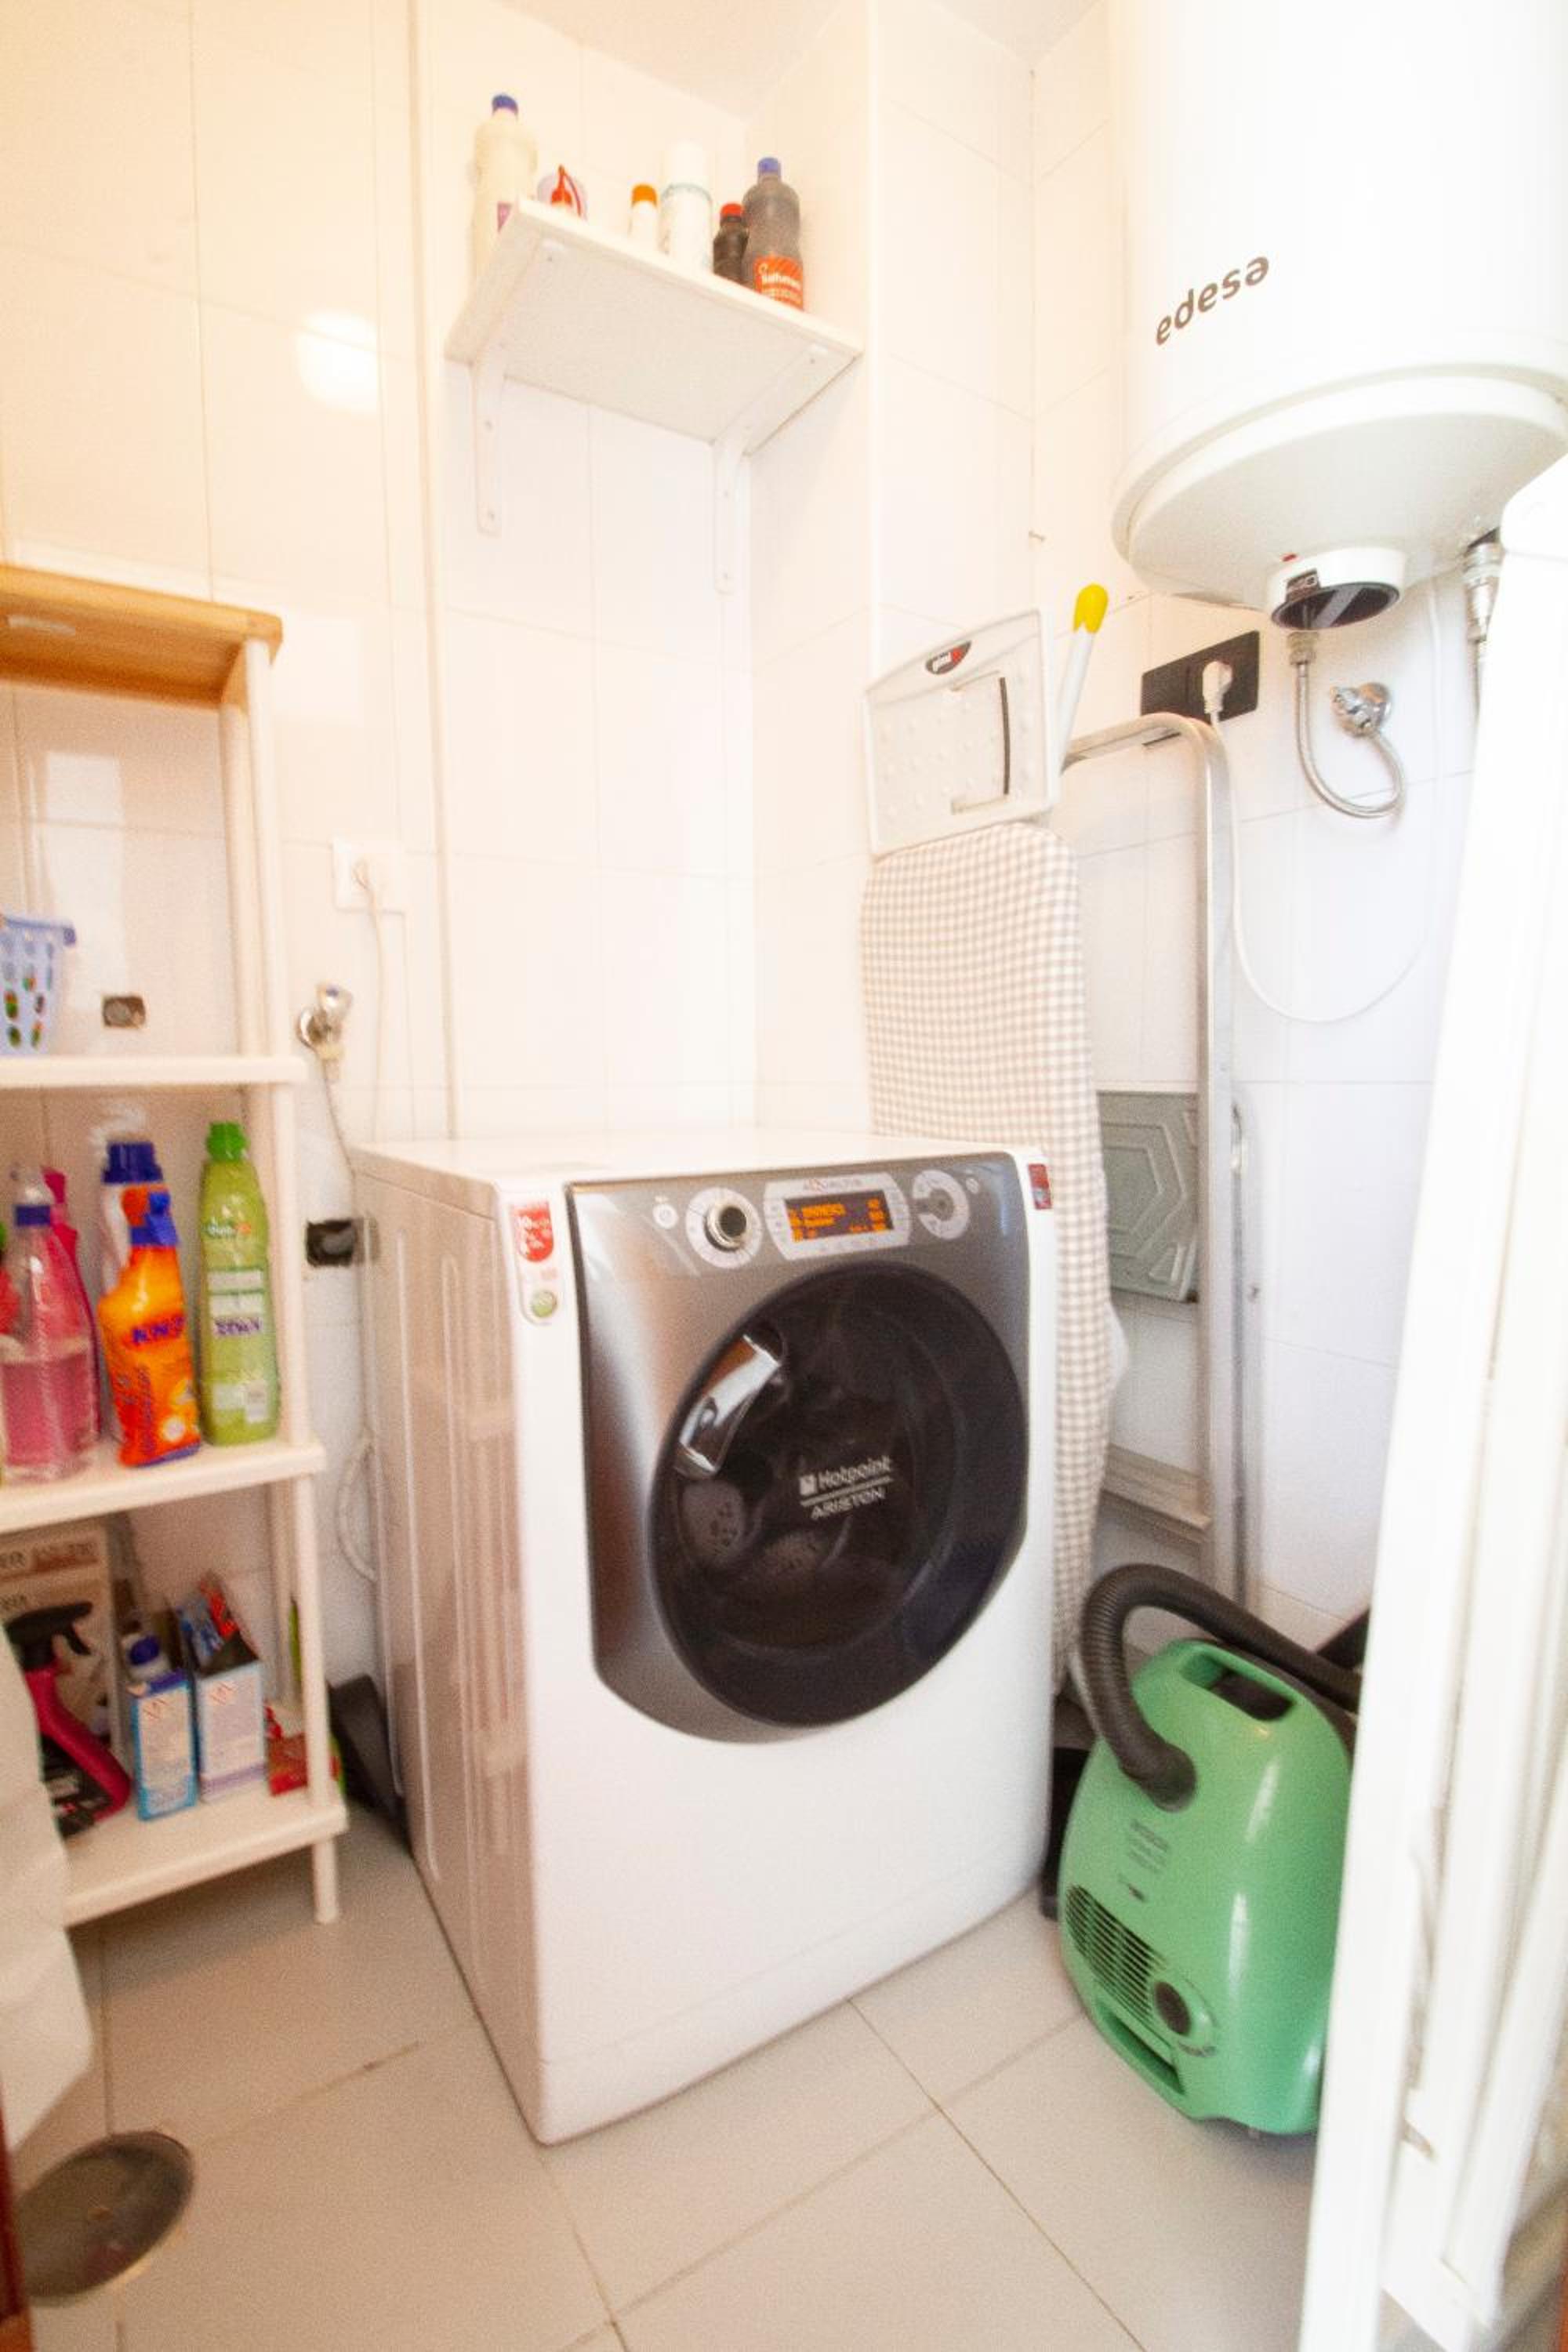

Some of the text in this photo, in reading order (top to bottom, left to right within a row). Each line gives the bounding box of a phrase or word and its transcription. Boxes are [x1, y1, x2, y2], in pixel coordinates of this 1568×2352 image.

[1156, 256, 1269, 346] edesa
[818, 1455, 891, 1489] Hotpoint
[811, 1486, 885, 1519] ARISTON
